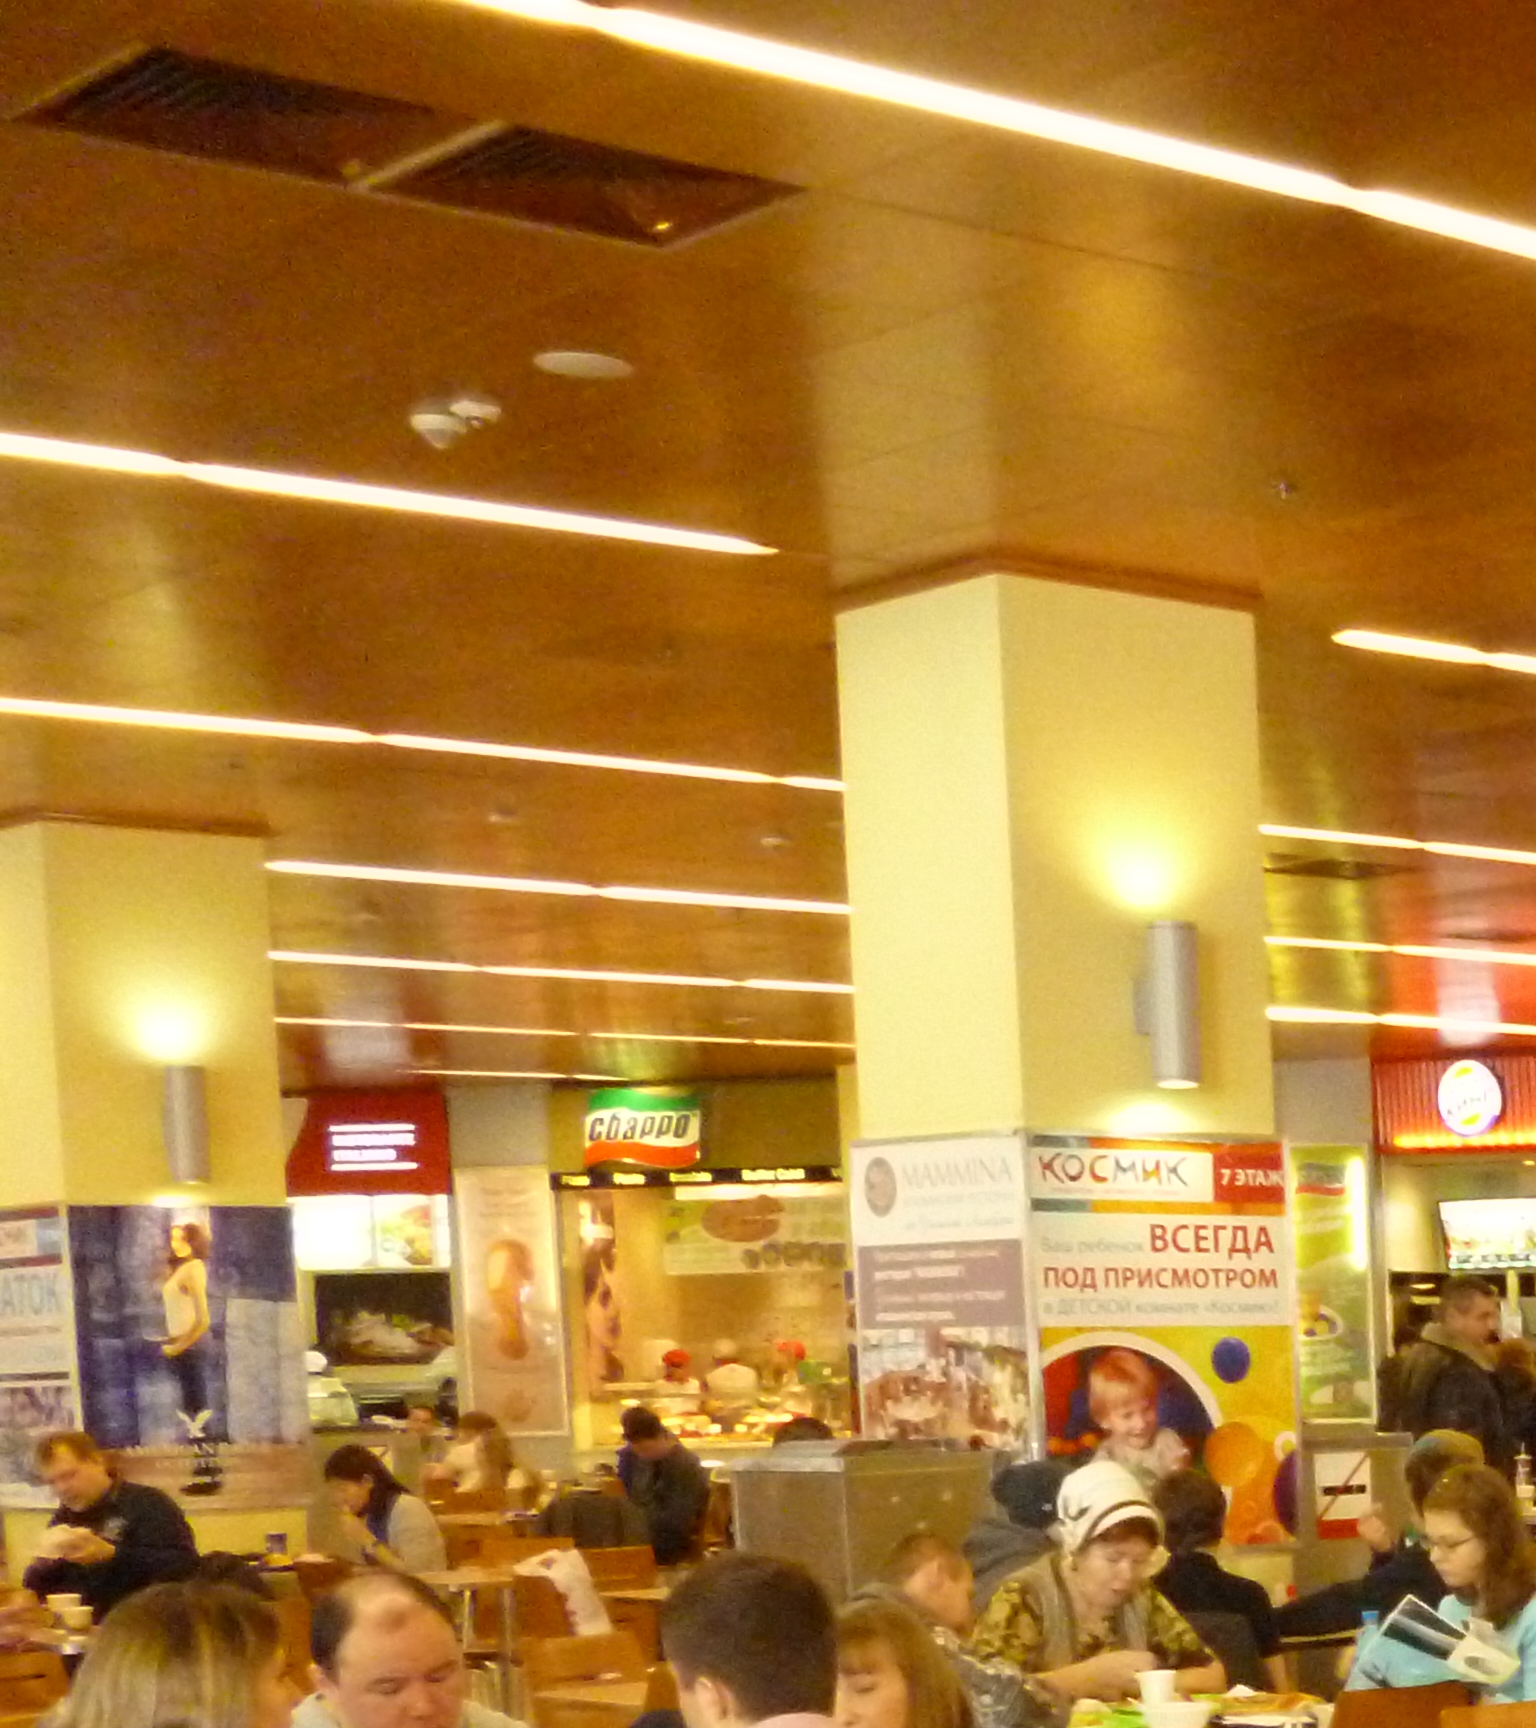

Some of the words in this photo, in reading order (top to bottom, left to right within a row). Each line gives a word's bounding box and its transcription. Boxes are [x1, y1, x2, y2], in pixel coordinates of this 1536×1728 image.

[902, 1156, 1013, 1190] MAMMINA
[1038, 1152, 1189, 1187] КОСМИК
[1220, 1168, 1230, 1186] 7
[1233, 1168, 1284, 1187] ЭТАЖ
[1149, 1223, 1275, 1261] ВСЕГДА
[1043, 1266, 1098, 1293] ПОД
[1104, 1267, 1279, 1289] ПРИСМОТРОМ
